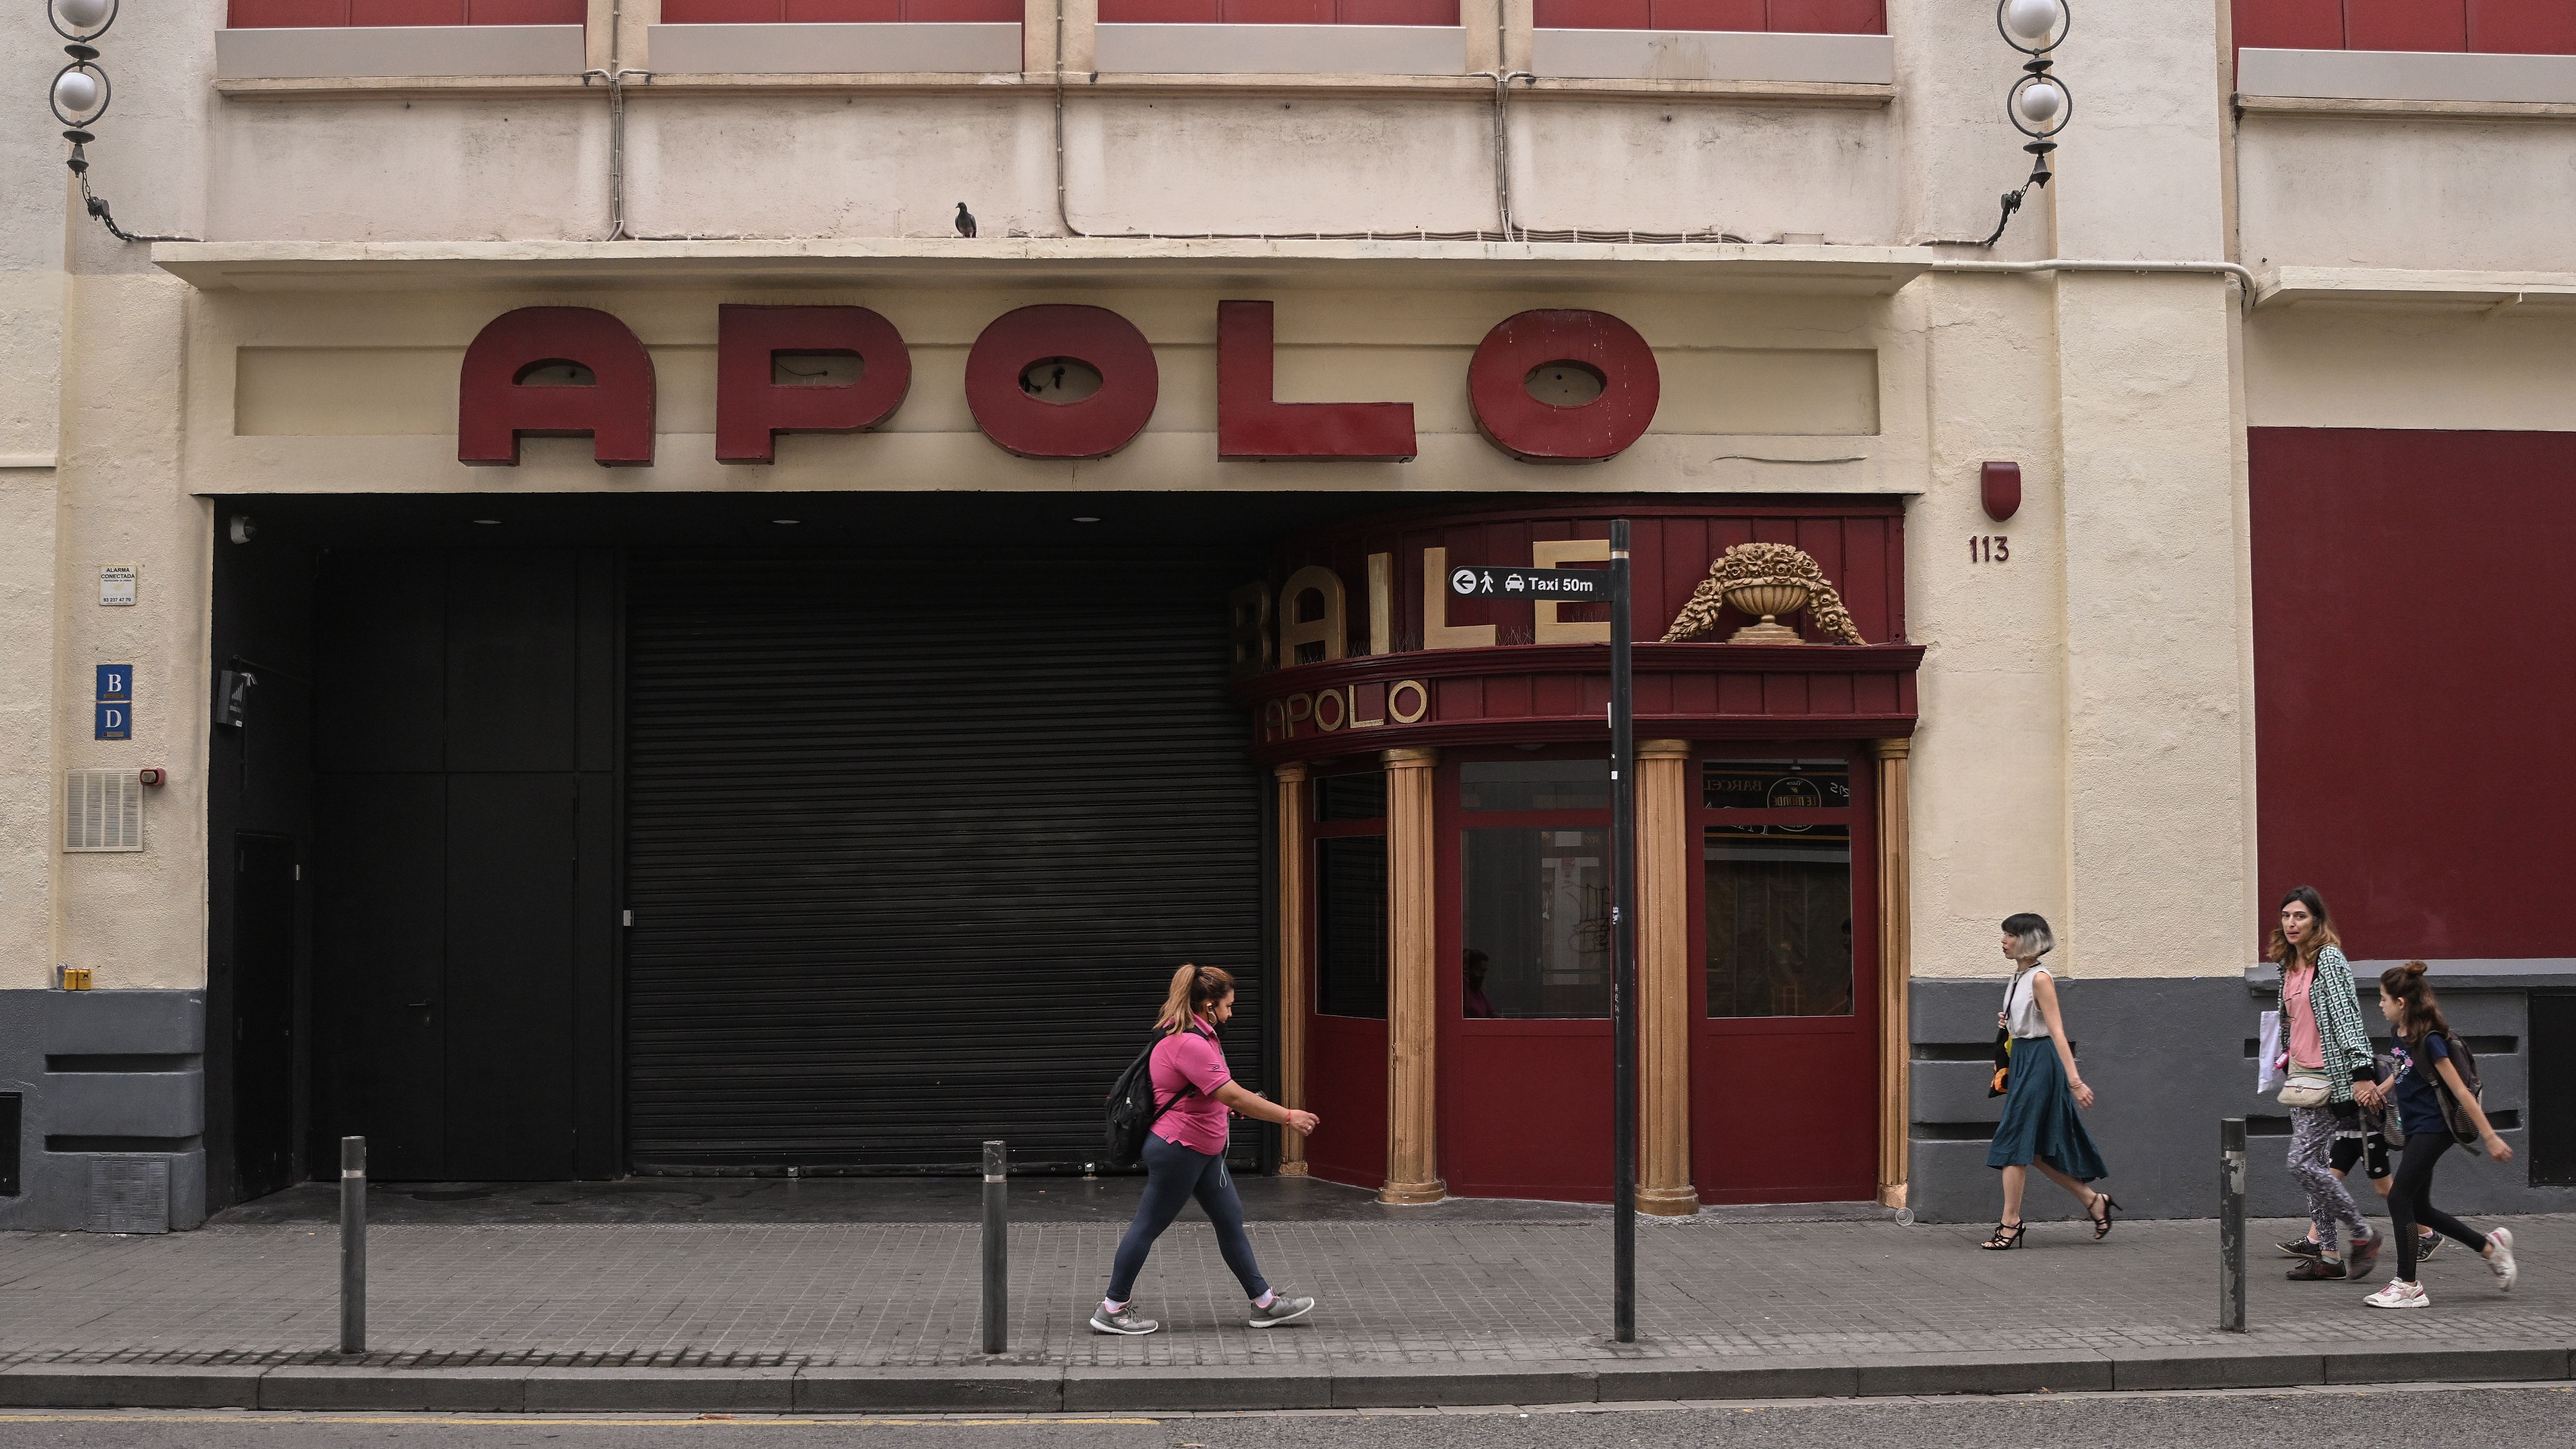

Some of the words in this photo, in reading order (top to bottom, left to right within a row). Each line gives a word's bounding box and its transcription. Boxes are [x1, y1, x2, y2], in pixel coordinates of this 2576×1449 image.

[458, 300, 1660, 467] APOLO
[1969, 535, 2009, 562] 113
[1529, 577, 1559, 592] Taxi
[1562, 578, 1593, 592] 50m
[1229, 540, 1611, 675] BAILE
[107, 674, 122, 692] B
[105, 710, 122, 727] D
[1265, 680, 1427, 742] APOLO
